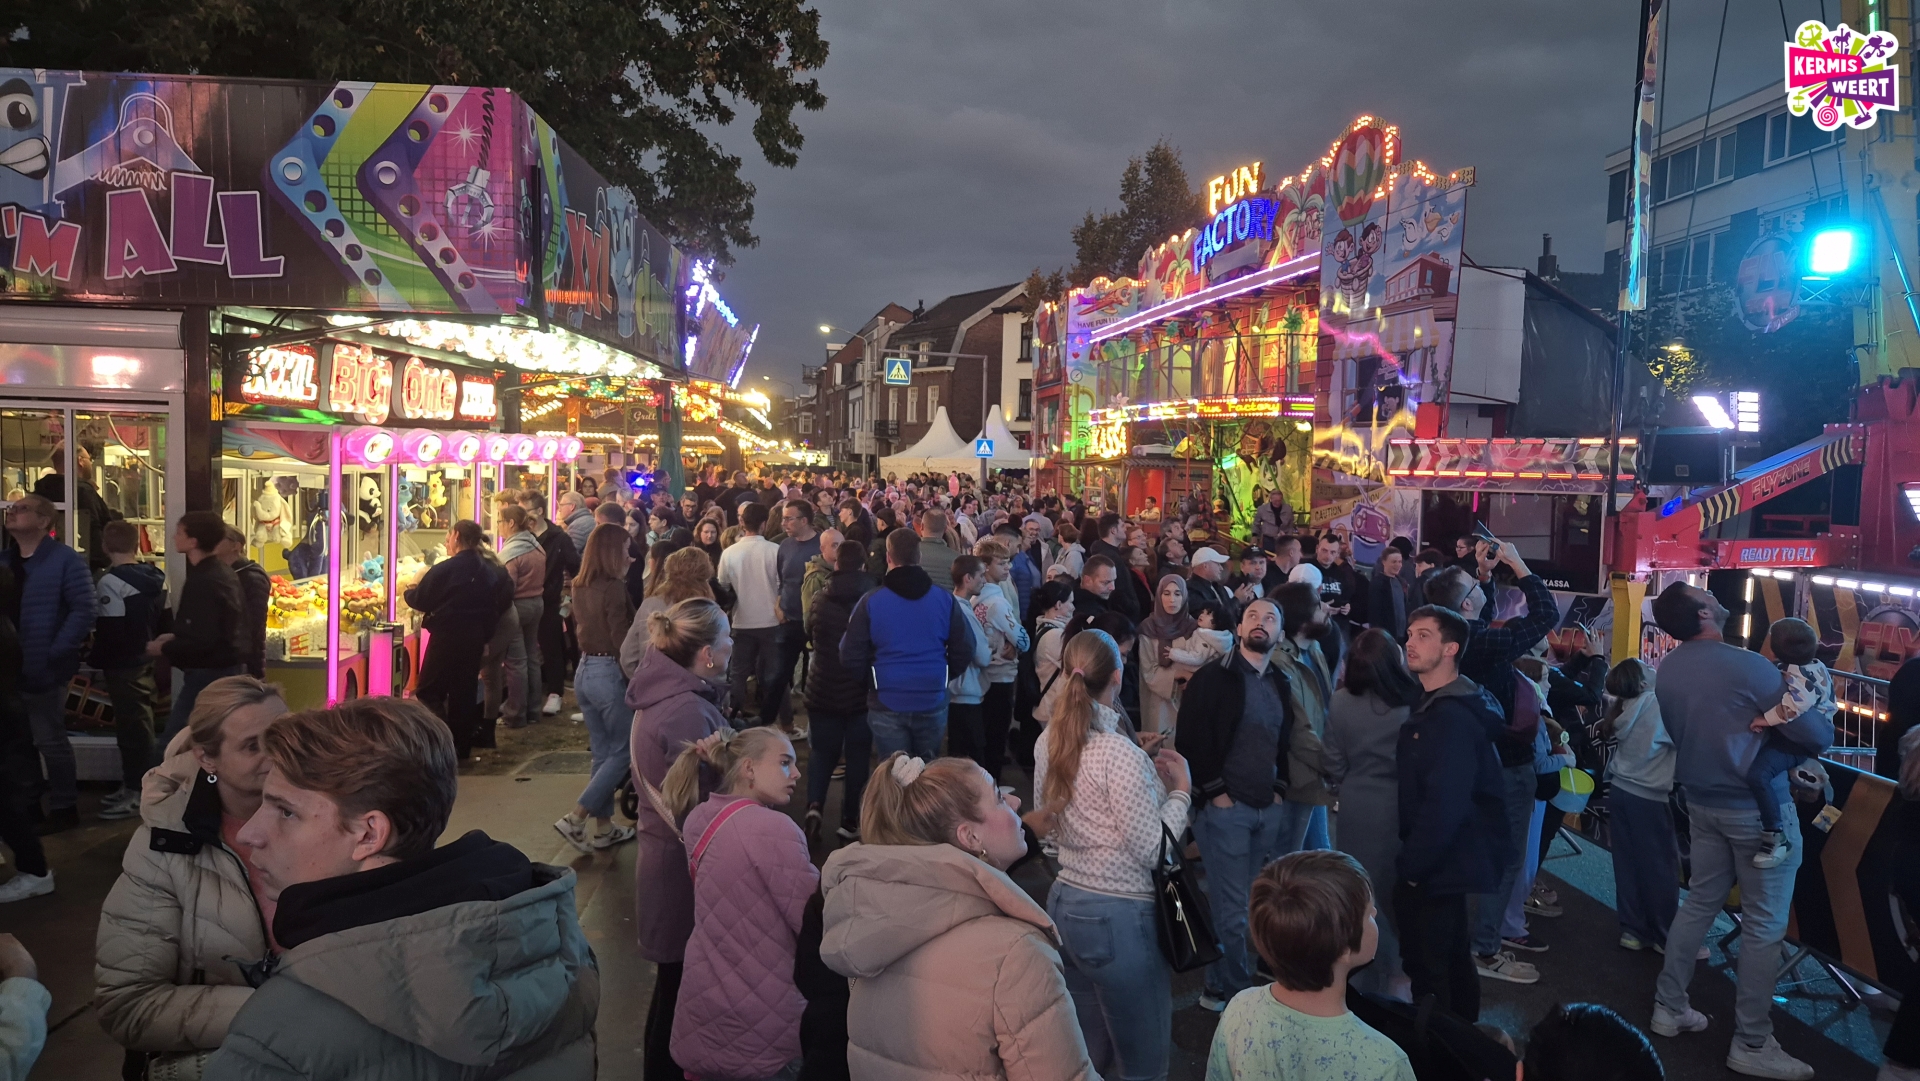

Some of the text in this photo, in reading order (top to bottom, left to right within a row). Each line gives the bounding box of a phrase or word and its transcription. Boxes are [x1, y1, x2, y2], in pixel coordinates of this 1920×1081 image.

[1208, 162, 1262, 215] FUN
[104, 172, 285, 280] ALL
[1193, 198, 1280, 275] FACTORY
[565, 208, 613, 320] XXL
[1095, 318, 1108, 326] FUN
[331, 345, 392, 423] Big
[1196, 401, 1281, 413] Fun Factory
[1315, 506, 1342, 521] CAUTION
[1740, 547, 1817, 562] READY TO FLY
[1543, 578, 1569, 588] KASSA
